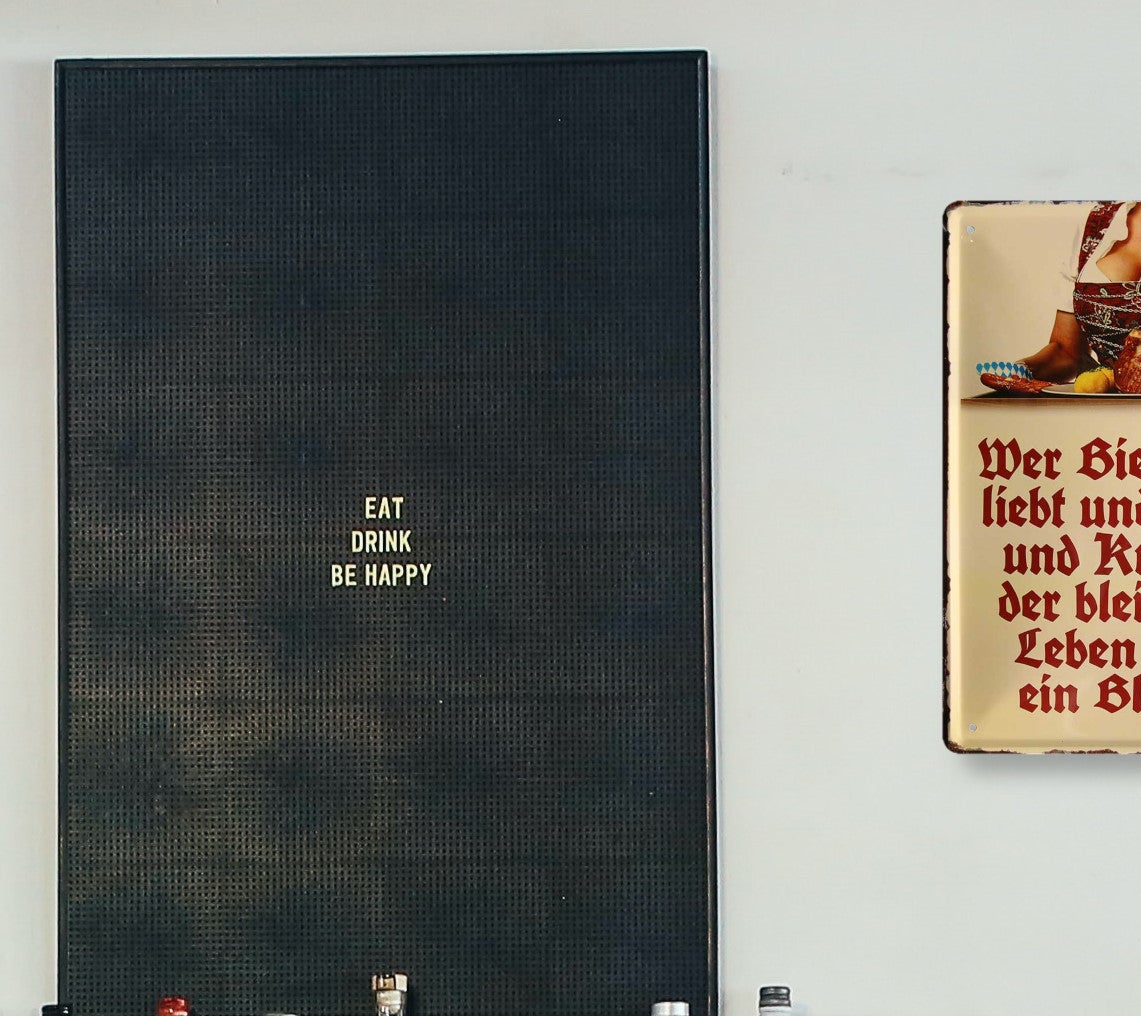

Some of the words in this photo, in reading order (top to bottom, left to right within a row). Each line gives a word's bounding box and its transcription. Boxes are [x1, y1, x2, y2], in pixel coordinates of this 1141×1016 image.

[977, 438, 1062, 481] Wer
[365, 496, 404, 520] EAT
[983, 486, 1066, 528] liebt
[351, 529, 412, 553] DRINK
[1004, 534, 1080, 576] und
[331, 563, 357, 587] BE
[365, 563, 432, 587] HAPPY
[998, 581, 1061, 622] der
[1015, 627, 1137, 670] Leben
[1019, 673, 1080, 714] ein
